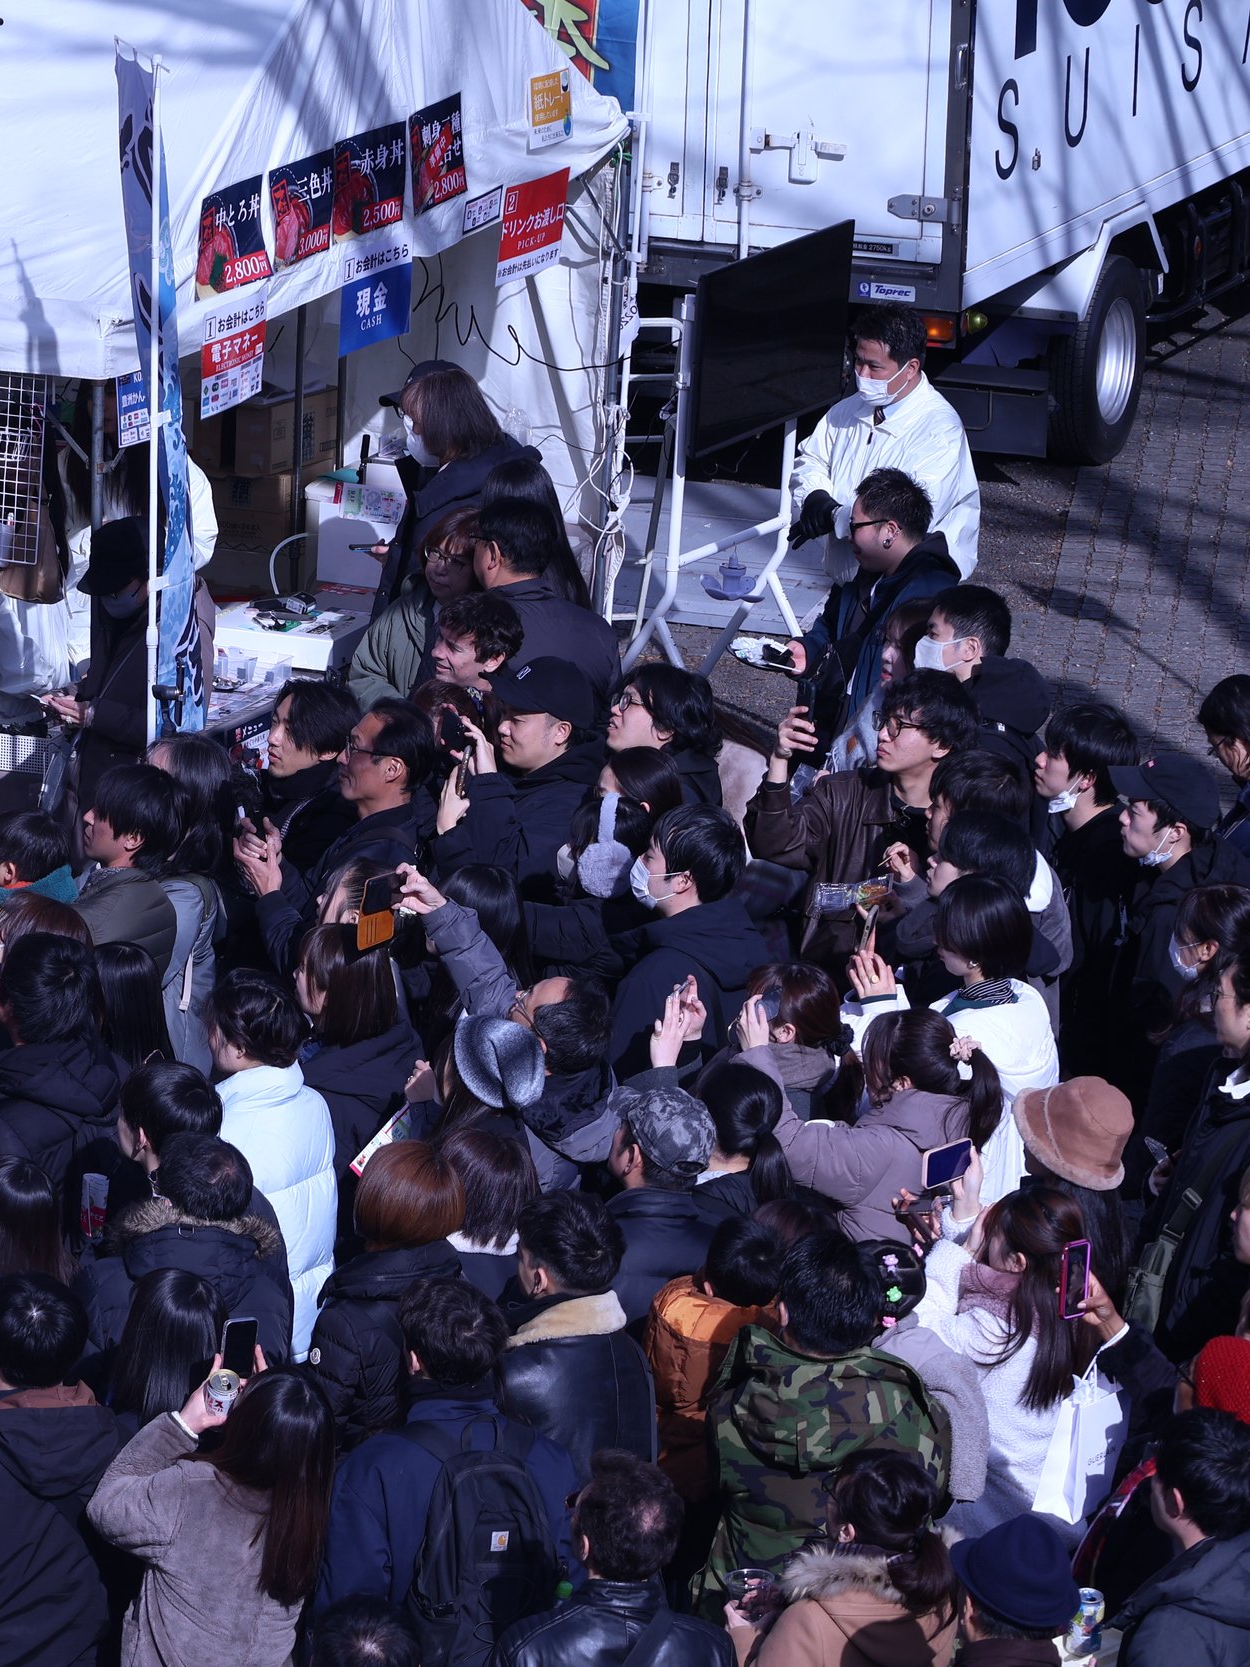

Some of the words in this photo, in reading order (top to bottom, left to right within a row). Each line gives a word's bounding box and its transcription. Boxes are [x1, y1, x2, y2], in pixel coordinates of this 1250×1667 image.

[361, 138, 405, 176] 赤身丼
[297, 166, 333, 203] 三色丼
[215, 192, 261, 232] 中とろ丼
[363, 200, 401, 227] 2,500円
[501, 203, 566, 240] ドリンクお渡し口
[517, 232, 546, 250] PICK-UP
[224, 255, 268, 284] 2,800円
[355, 244, 409, 274] お会計はこちら
[356, 281, 388, 318] 現金
[875, 284, 911, 297] Toprec
[217, 301, 265, 333] お会計はこちら
[360, 314, 382, 331] CASH
[211, 333, 258, 363] 電子マネー
